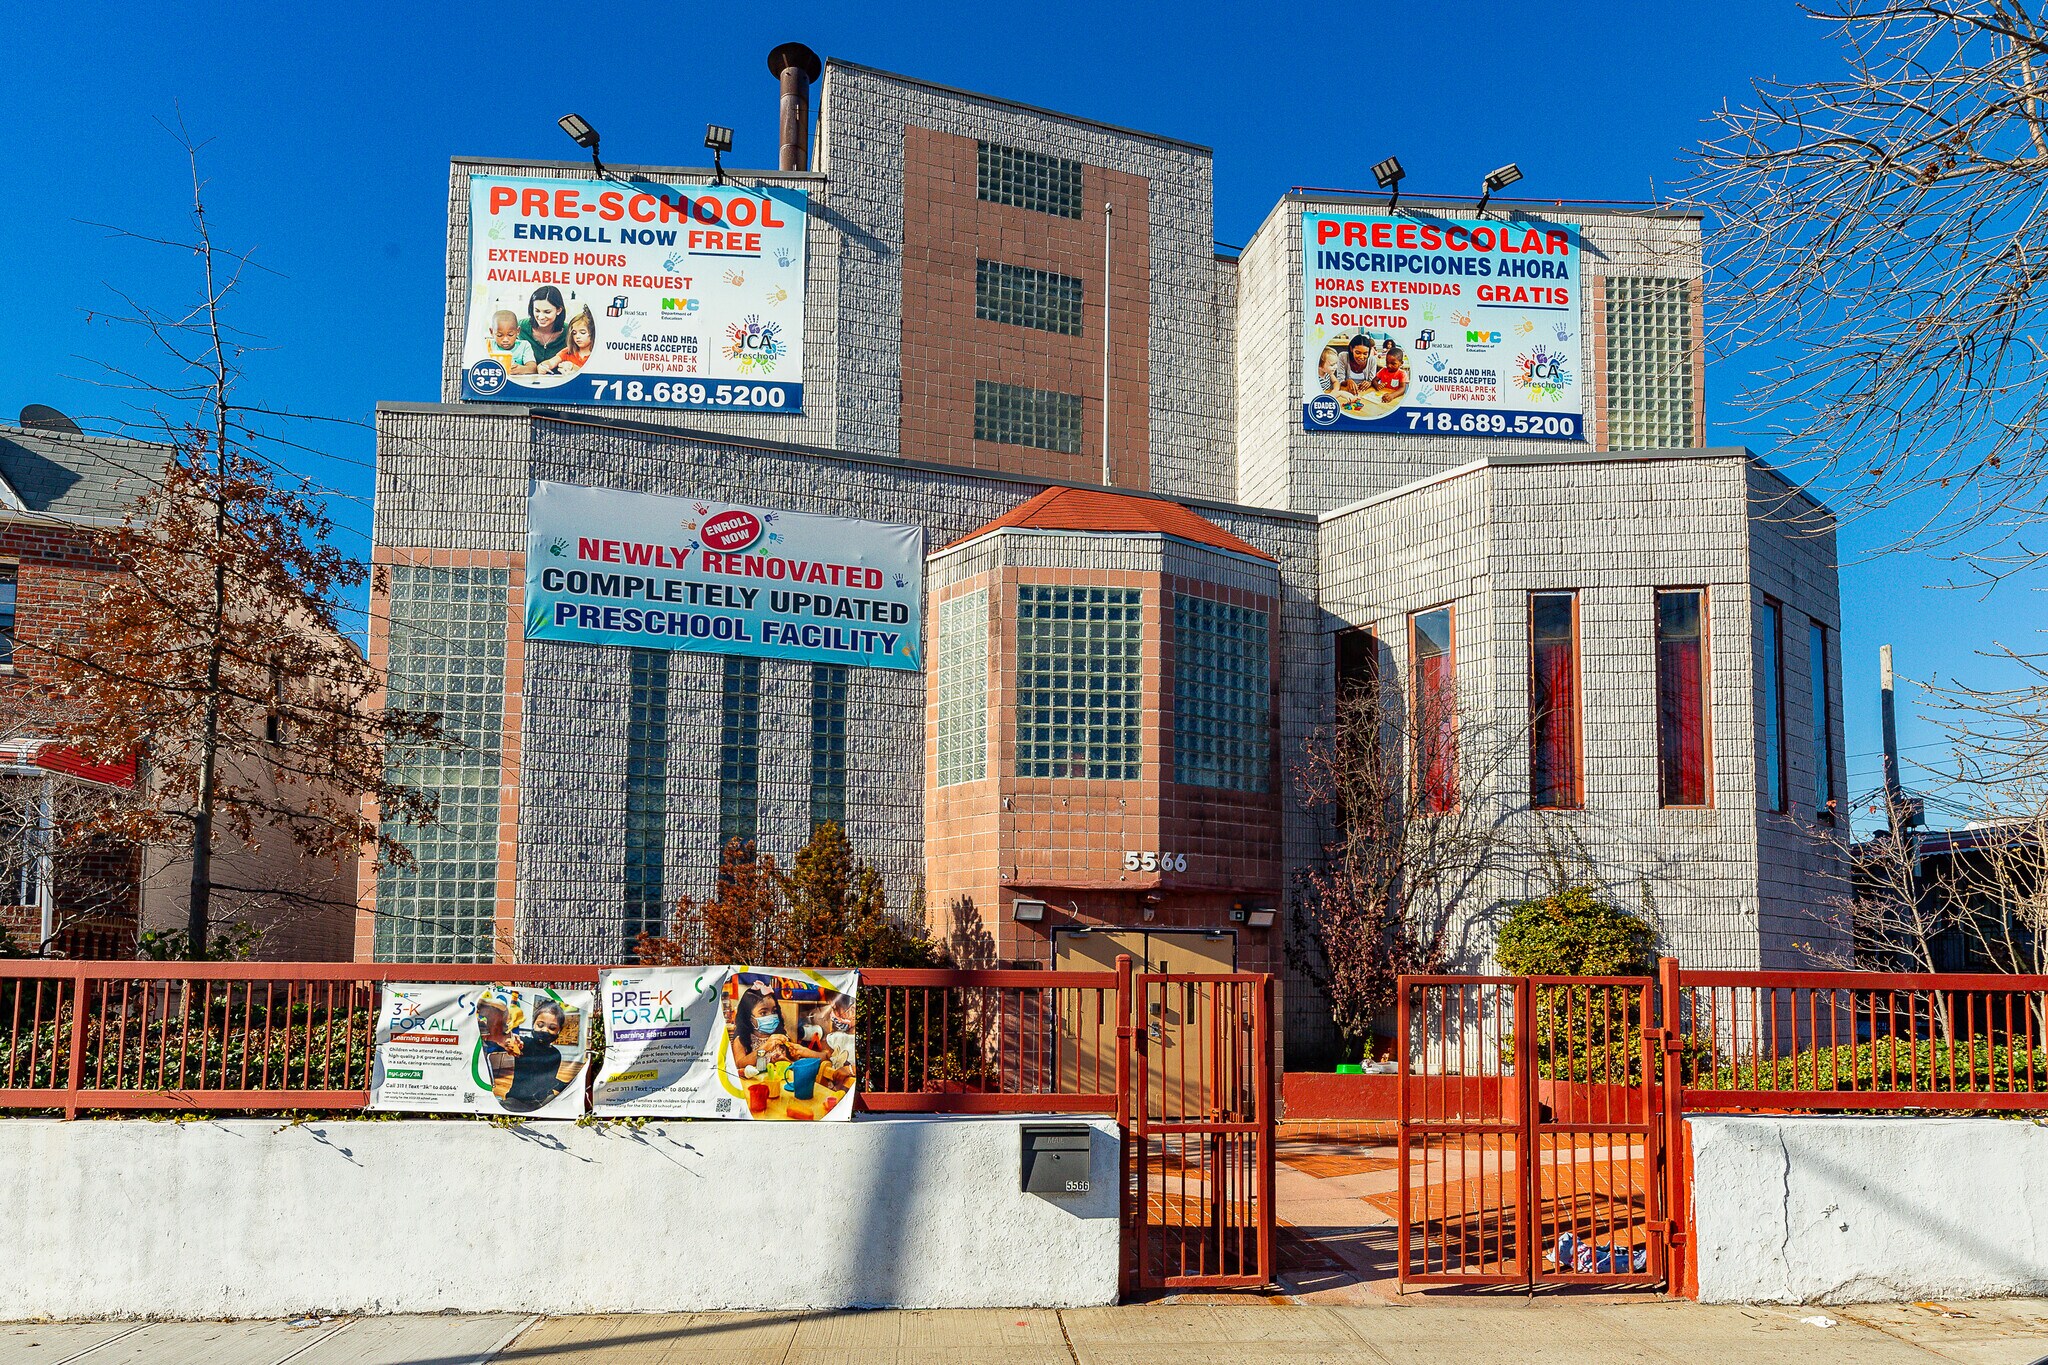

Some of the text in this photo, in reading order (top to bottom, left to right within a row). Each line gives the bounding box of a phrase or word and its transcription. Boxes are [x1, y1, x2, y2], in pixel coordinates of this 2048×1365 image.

[490, 186, 785, 228] PRE-SCHOOL
[513, 224, 761, 251] ENROLL NOW FREE
[1317, 220, 1569, 255] PREESCOLAR
[488, 249, 627, 267] EXTENDED HOURS
[1317, 251, 1569, 279] INSCRIPCIONES AHORA
[487, 269, 693, 290] AVAILABLE UPON REQUEST
[1315, 278, 1461, 296] HORAS EXTENDIDAS
[1476, 285, 1569, 305] GRATIS
[662, 298, 700, 311] NYC
[1315, 296, 1410, 311] DISPONIBLES
[1315, 313, 1408, 328] A SOLICITUD
[641, 334, 698, 344] ACD AND HRA
[737, 334, 773, 350] JCA
[1466, 331, 1502, 343] NYC
[606, 342, 698, 354] VOUCHERS ACCEPTED
[624, 353, 697, 363] UNIVERSAL PRE-K
[733, 351, 777, 361] Preschool
[472, 369, 503, 378] AGES
[642, 363, 697, 373] (UPK) AND 3K
[1448, 368, 1496, 377] ACD AND HRA
[1527, 364, 1560, 379] JCA
[475, 377, 499, 387] 3-5
[1419, 375, 1497, 385] VOUCHERS ACCEPTED
[1523, 381, 1565, 390] Preschool
[591, 380, 786, 407] 718.689.5200
[1434, 384, 1473, 393] UNIVERSAL
[1450, 393, 1497, 402] (UPK) AND 3K
[1314, 401, 1336, 410] EDADES
[1315, 409, 1334, 419] 3-5
[1406, 412, 1574, 436] 718.689.5200
[705, 515, 753, 538] ENROLL
[719, 527, 750, 547] NOW
[578, 536, 884, 591] NEWLY RENOVATED
[542, 567, 909, 625] COMPLETELY UPDATED
[553, 601, 900, 657] PRESCHOOL FACILITY
[1125, 851, 1187, 873] 5566
[611, 990, 673, 1007] PRE-K
[393, 1003, 421, 1016] 3-K
[611, 1007, 691, 1025] FOR ALL
[390, 1018, 458, 1031] FOR ALL
[615, 1032, 645, 1040] Learning
[646, 1030, 667, 1039] starts
[609, 1072, 655, 1081] nyc.gov/prek
[1066, 1181, 1089, 1190] 5566
